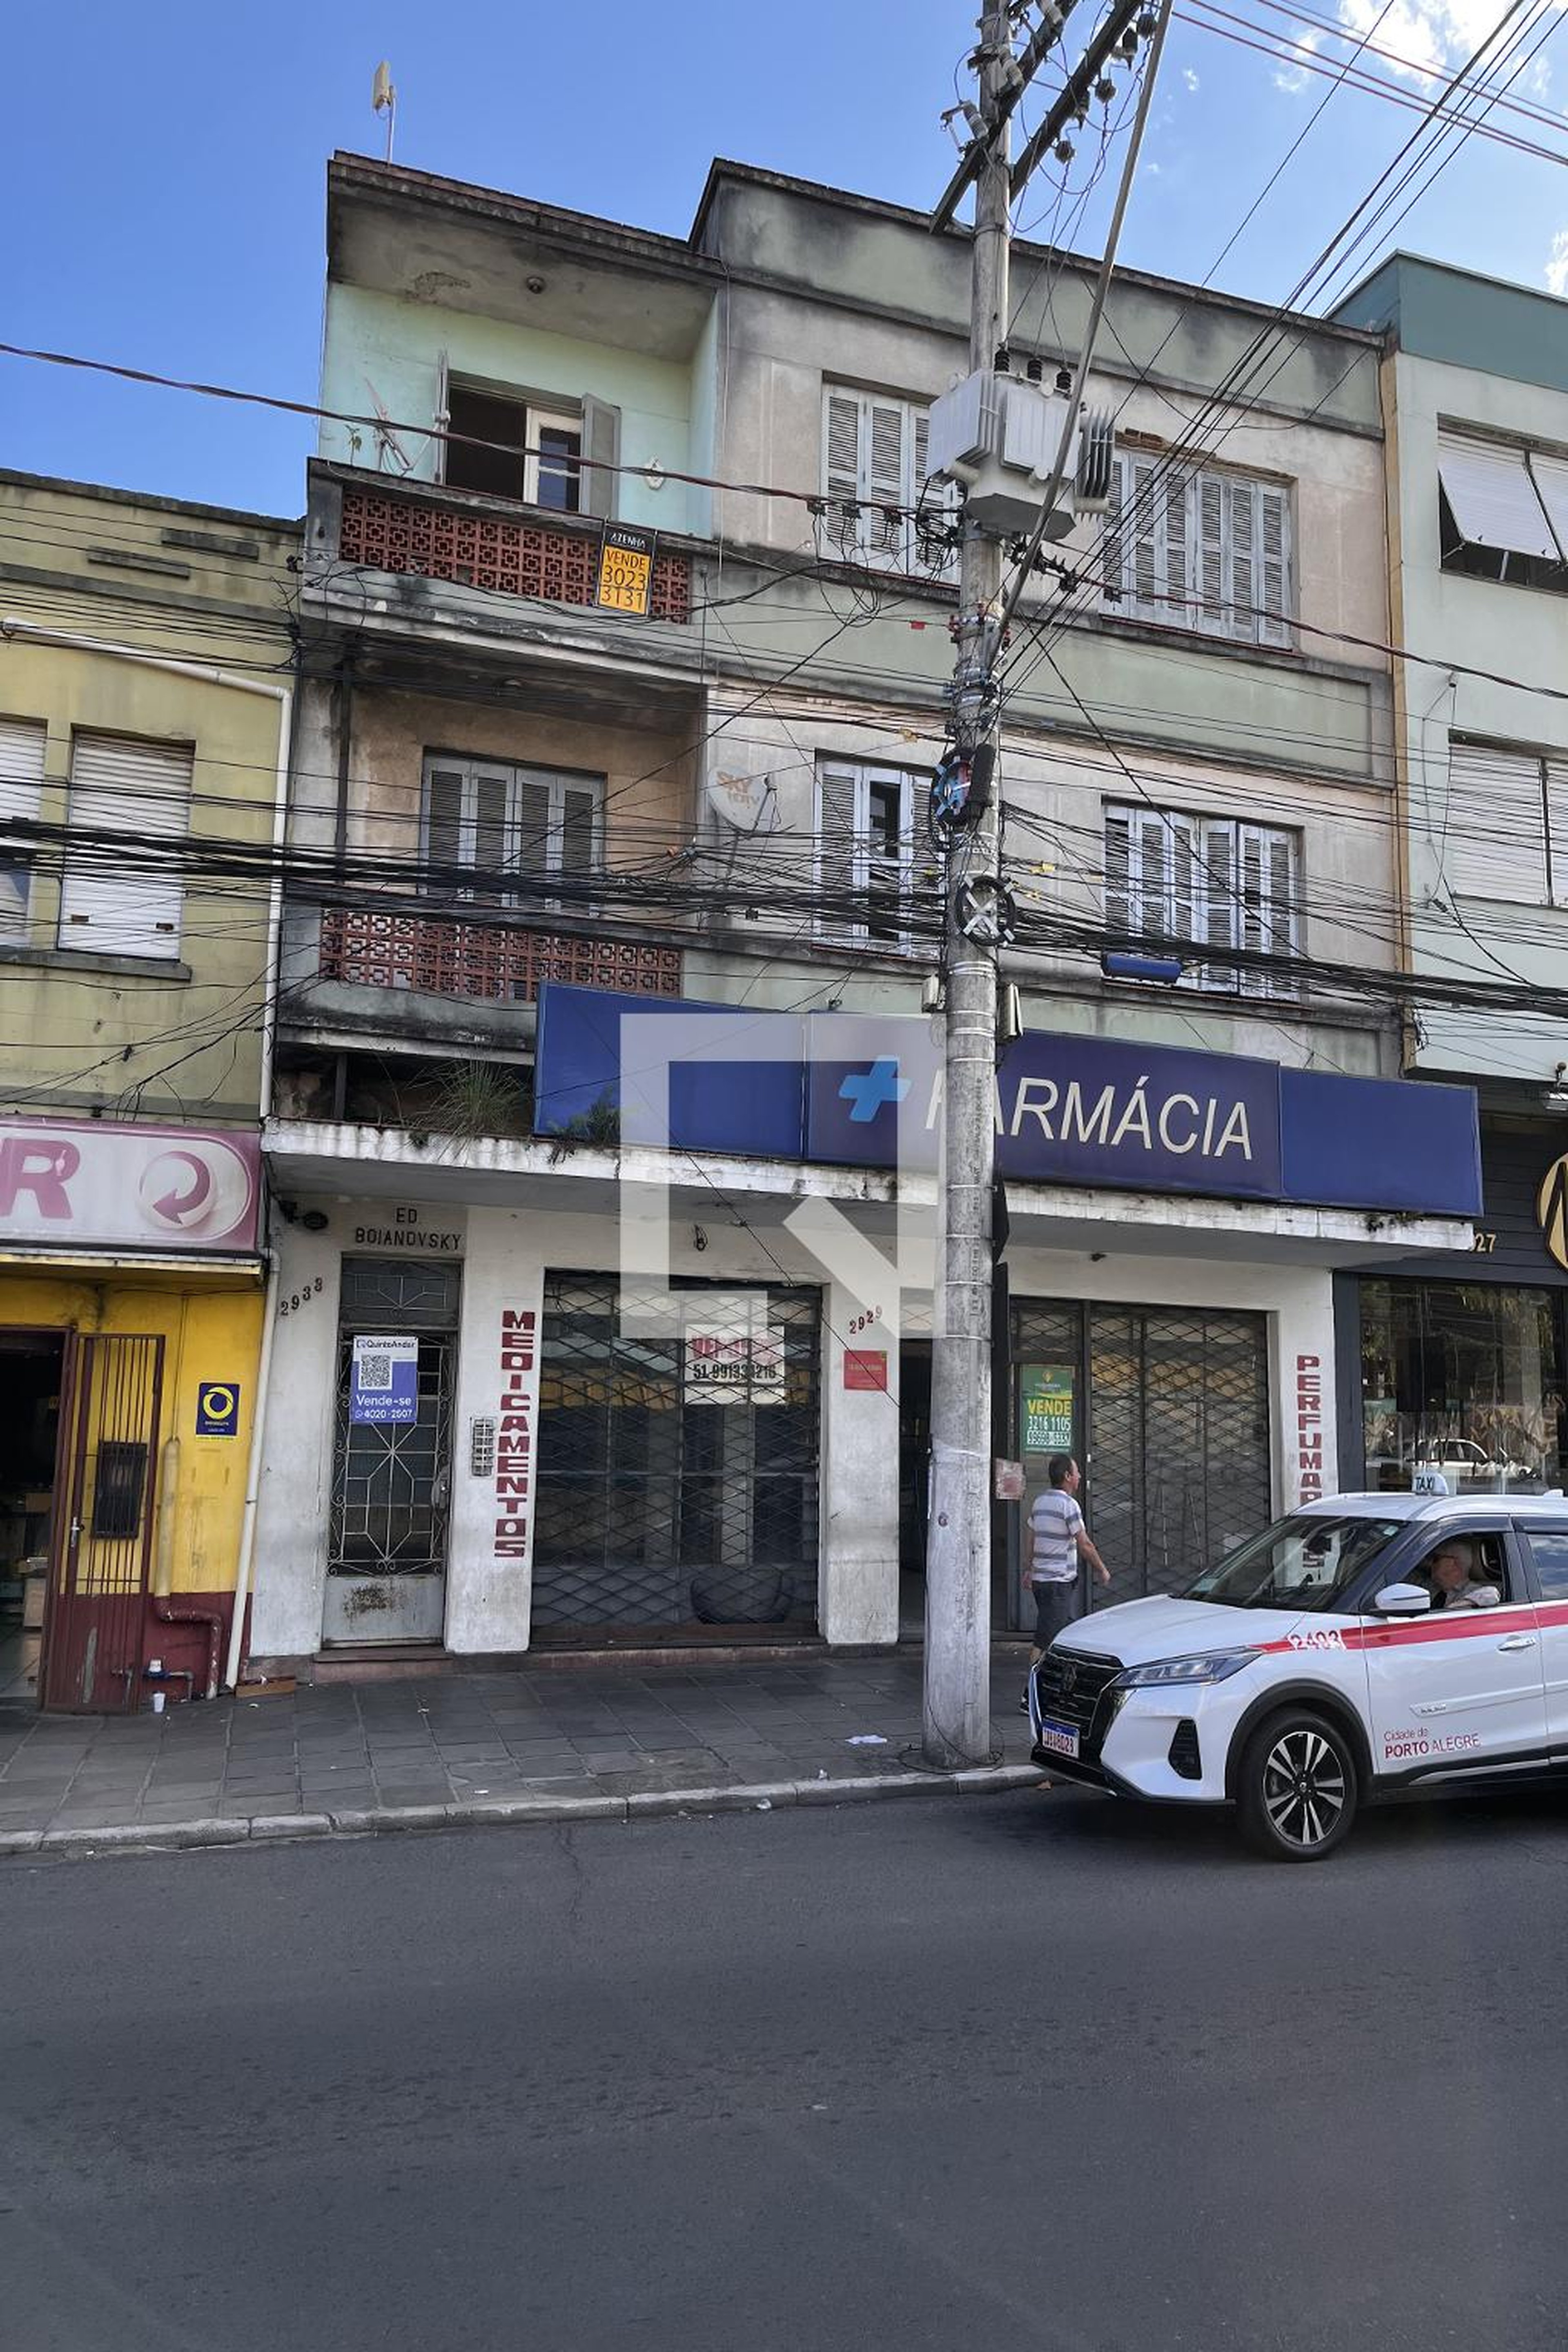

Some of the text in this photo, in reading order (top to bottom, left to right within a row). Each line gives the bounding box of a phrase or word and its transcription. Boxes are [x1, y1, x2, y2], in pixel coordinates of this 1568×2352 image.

[606, 549, 646, 570] VENDE
[603, 564, 646, 591] 3023
[396, 1207, 417, 1223] ED
[355, 1227, 462, 1250] BOIANOVSKY
[1470, 1234, 1496, 1253] 27
[281, 1277, 323, 1316] 2933
[849, 1305, 882, 1334] 2929
[356, 1394, 412, 1406] Vende-se
[1027, 1399, 1072, 1416] VENDE
[1028, 1415, 1071, 1431] 3216 1105
[494, 1310, 535, 1557] MEDICAMENTOS
[1415, 1477, 1435, 1490] TAXI
[1384, 1730, 1415, 1742] Cidade
[1385, 1733, 1481, 1758] PORTO ALEGRE
